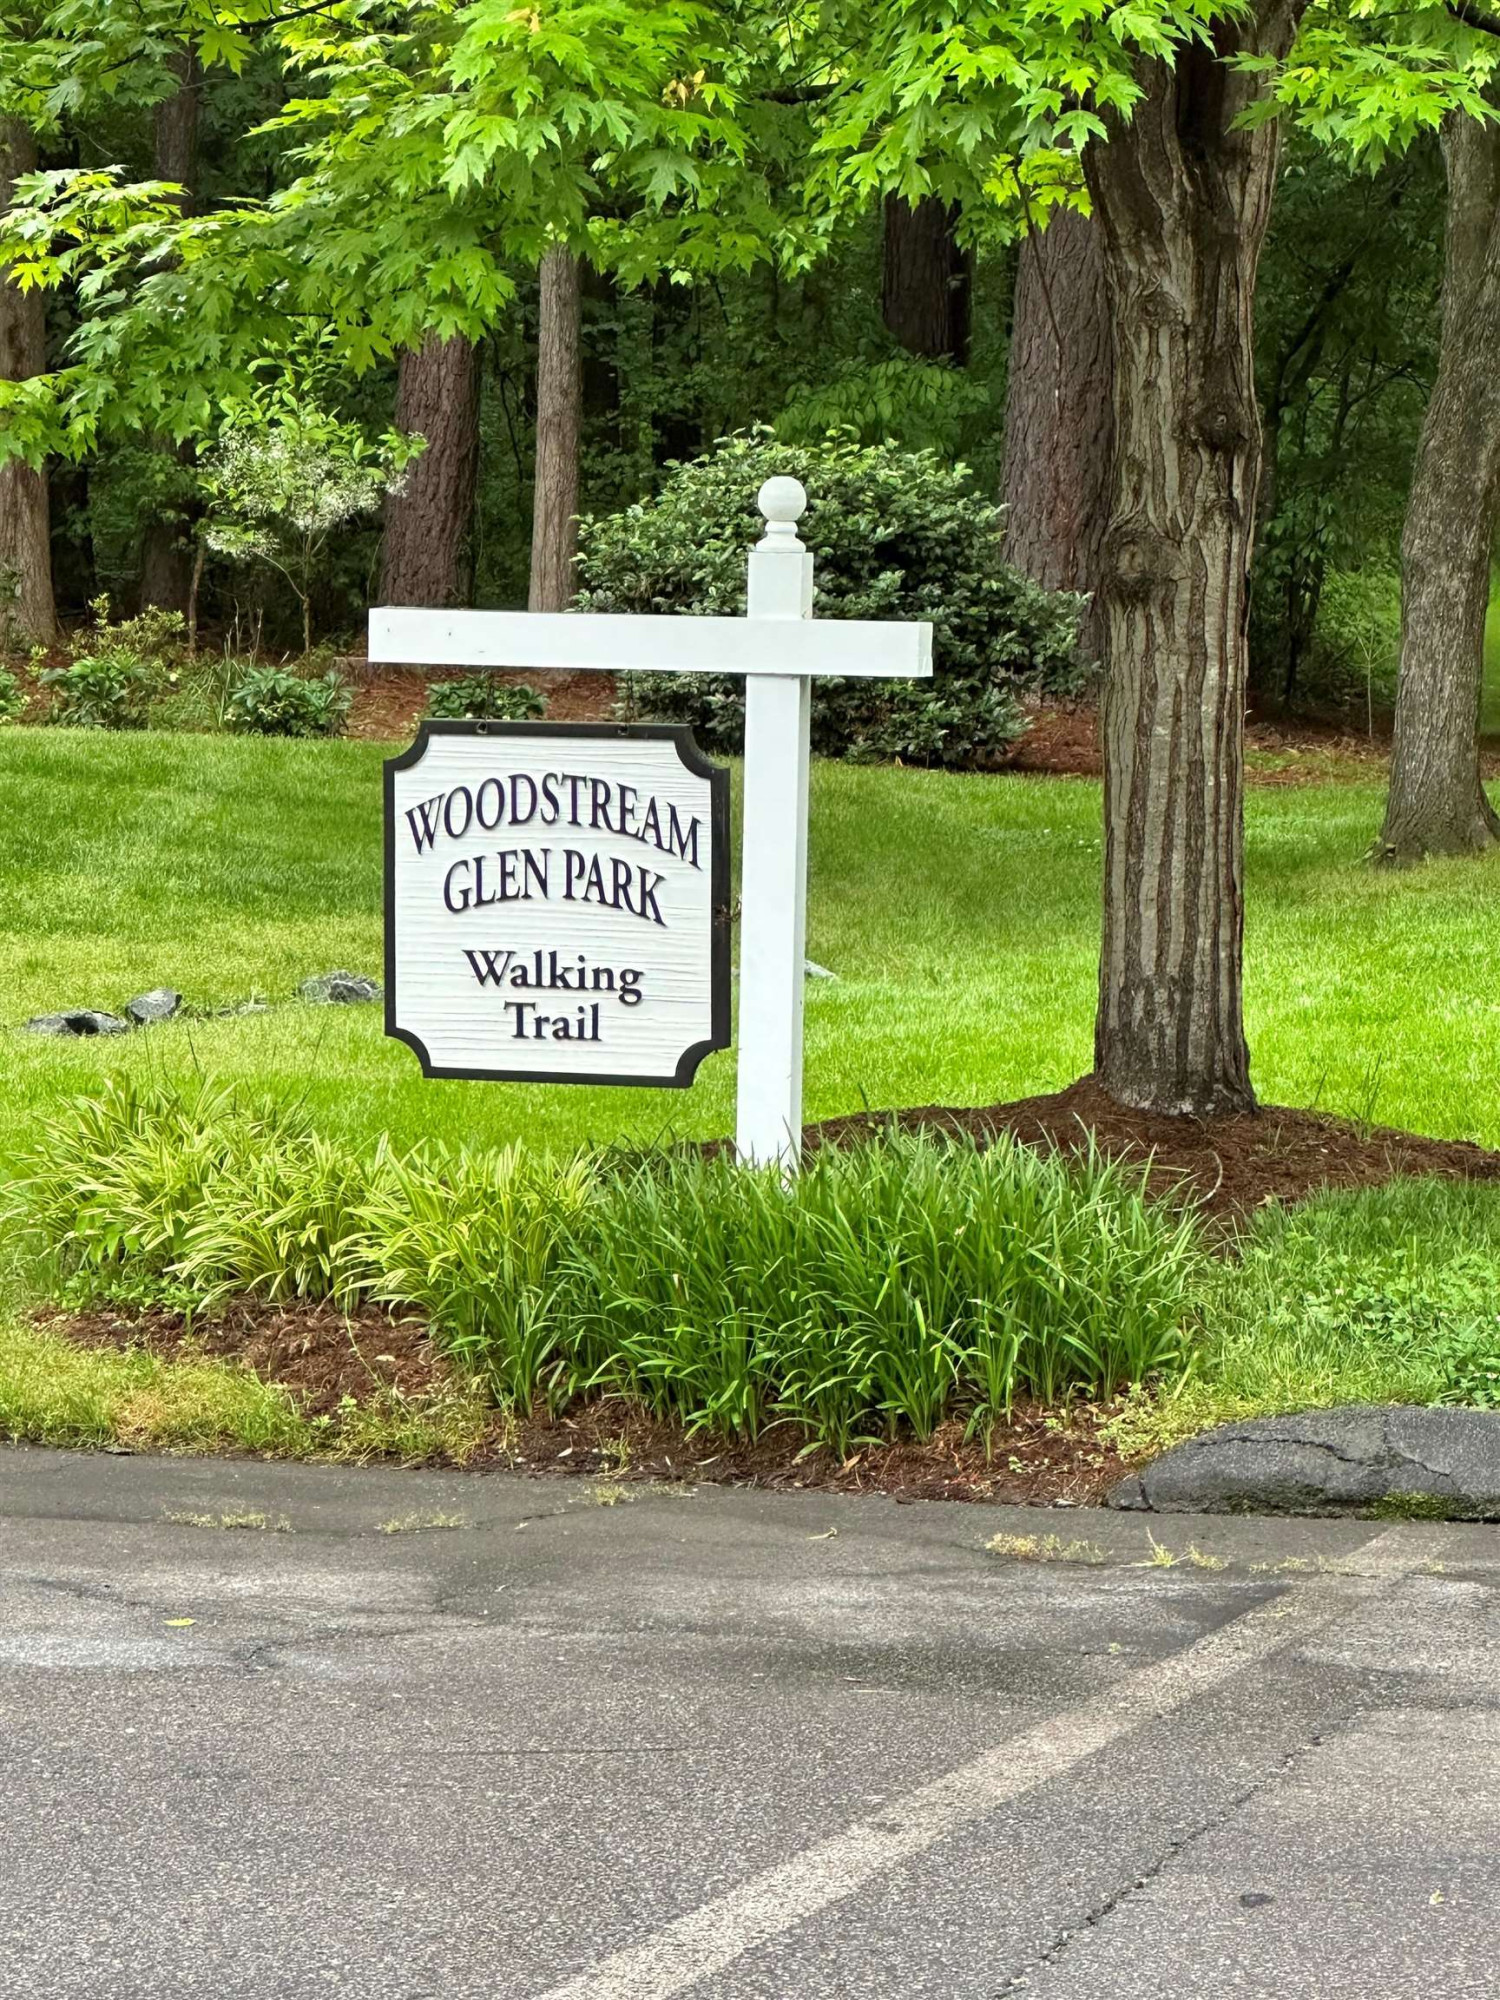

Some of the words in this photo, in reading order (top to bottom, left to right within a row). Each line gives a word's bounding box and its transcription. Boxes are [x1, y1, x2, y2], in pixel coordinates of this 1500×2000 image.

[404, 772, 702, 870] WOODSTREAM
[443, 848, 551, 914] GLEN
[562, 849, 667, 927] PARK
[462, 949, 644, 1006] Walking
[503, 1001, 602, 1042] Trail
